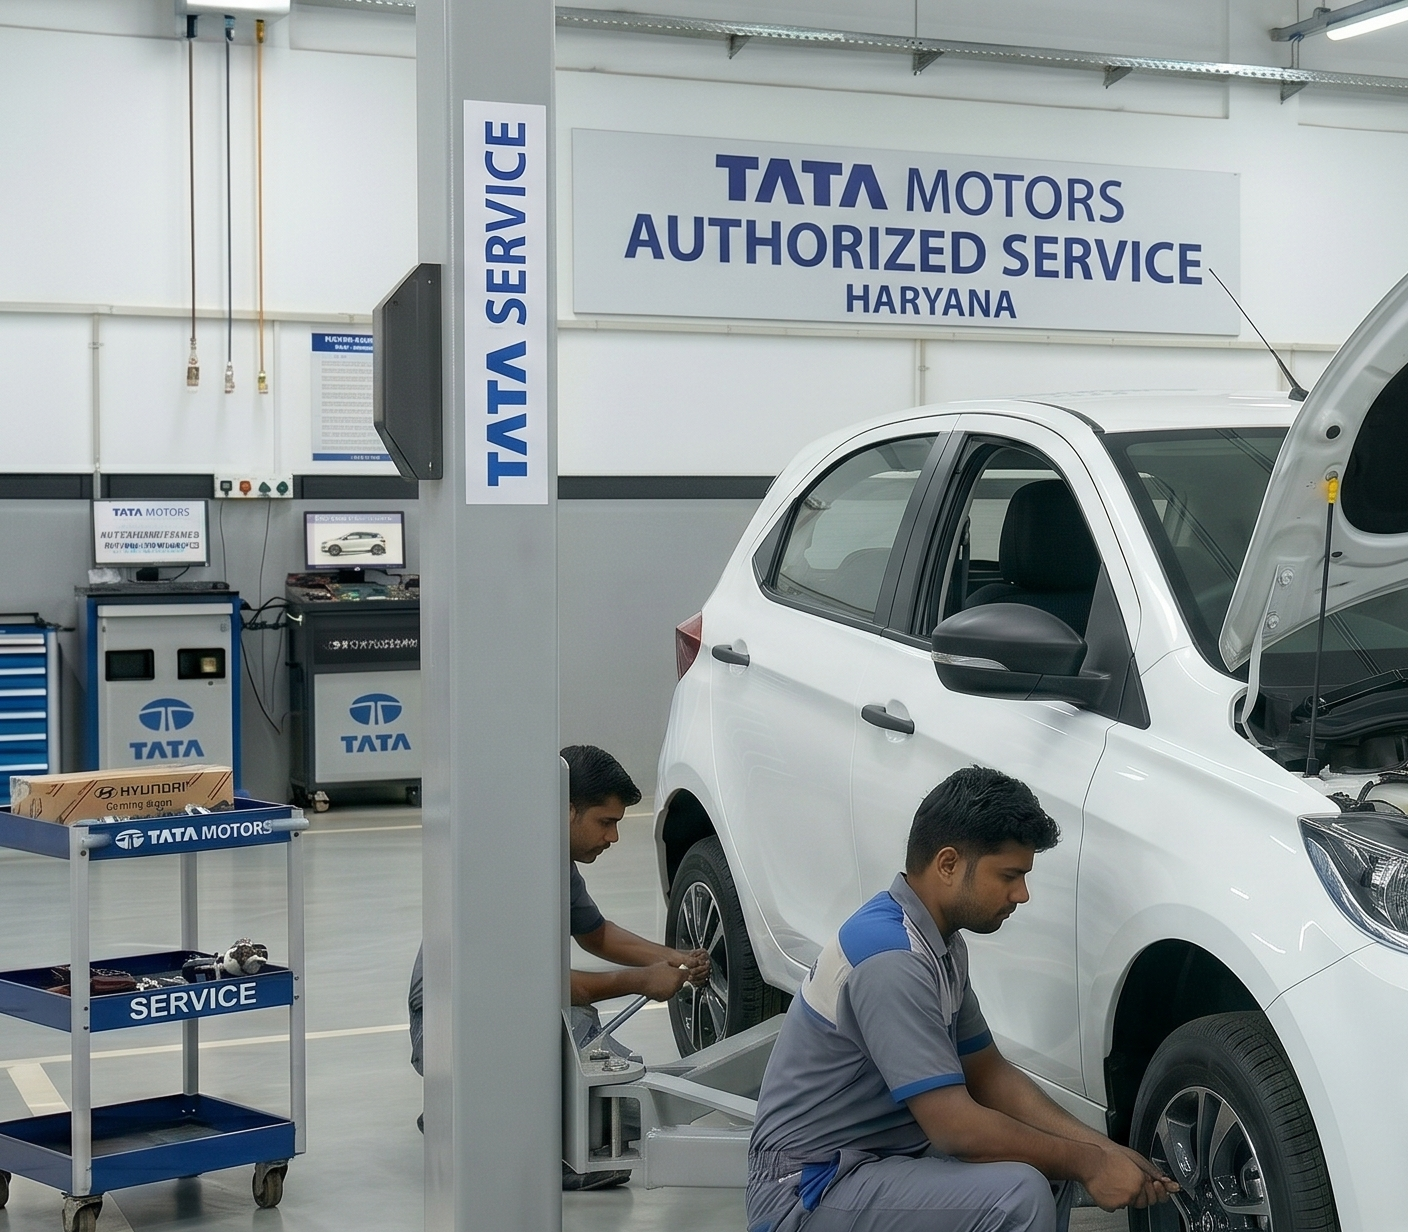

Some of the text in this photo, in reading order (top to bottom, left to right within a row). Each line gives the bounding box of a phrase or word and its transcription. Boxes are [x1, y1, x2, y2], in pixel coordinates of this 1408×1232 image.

[715, 153, 1125, 224] TATA MOTORS
[624, 213, 1203, 286] AUTHORIZED SERVICE
[484, 120, 528, 487] TATA SERVICE
[846, 283, 1017, 319] HARYANA
[112, 508, 190, 517] TATA MOTORS
[129, 739, 205, 760] TATA
[340, 733, 412, 754] TATA
[147, 819, 273, 845] TATA MOTORS
[130, 982, 257, 1020] SERVICE
